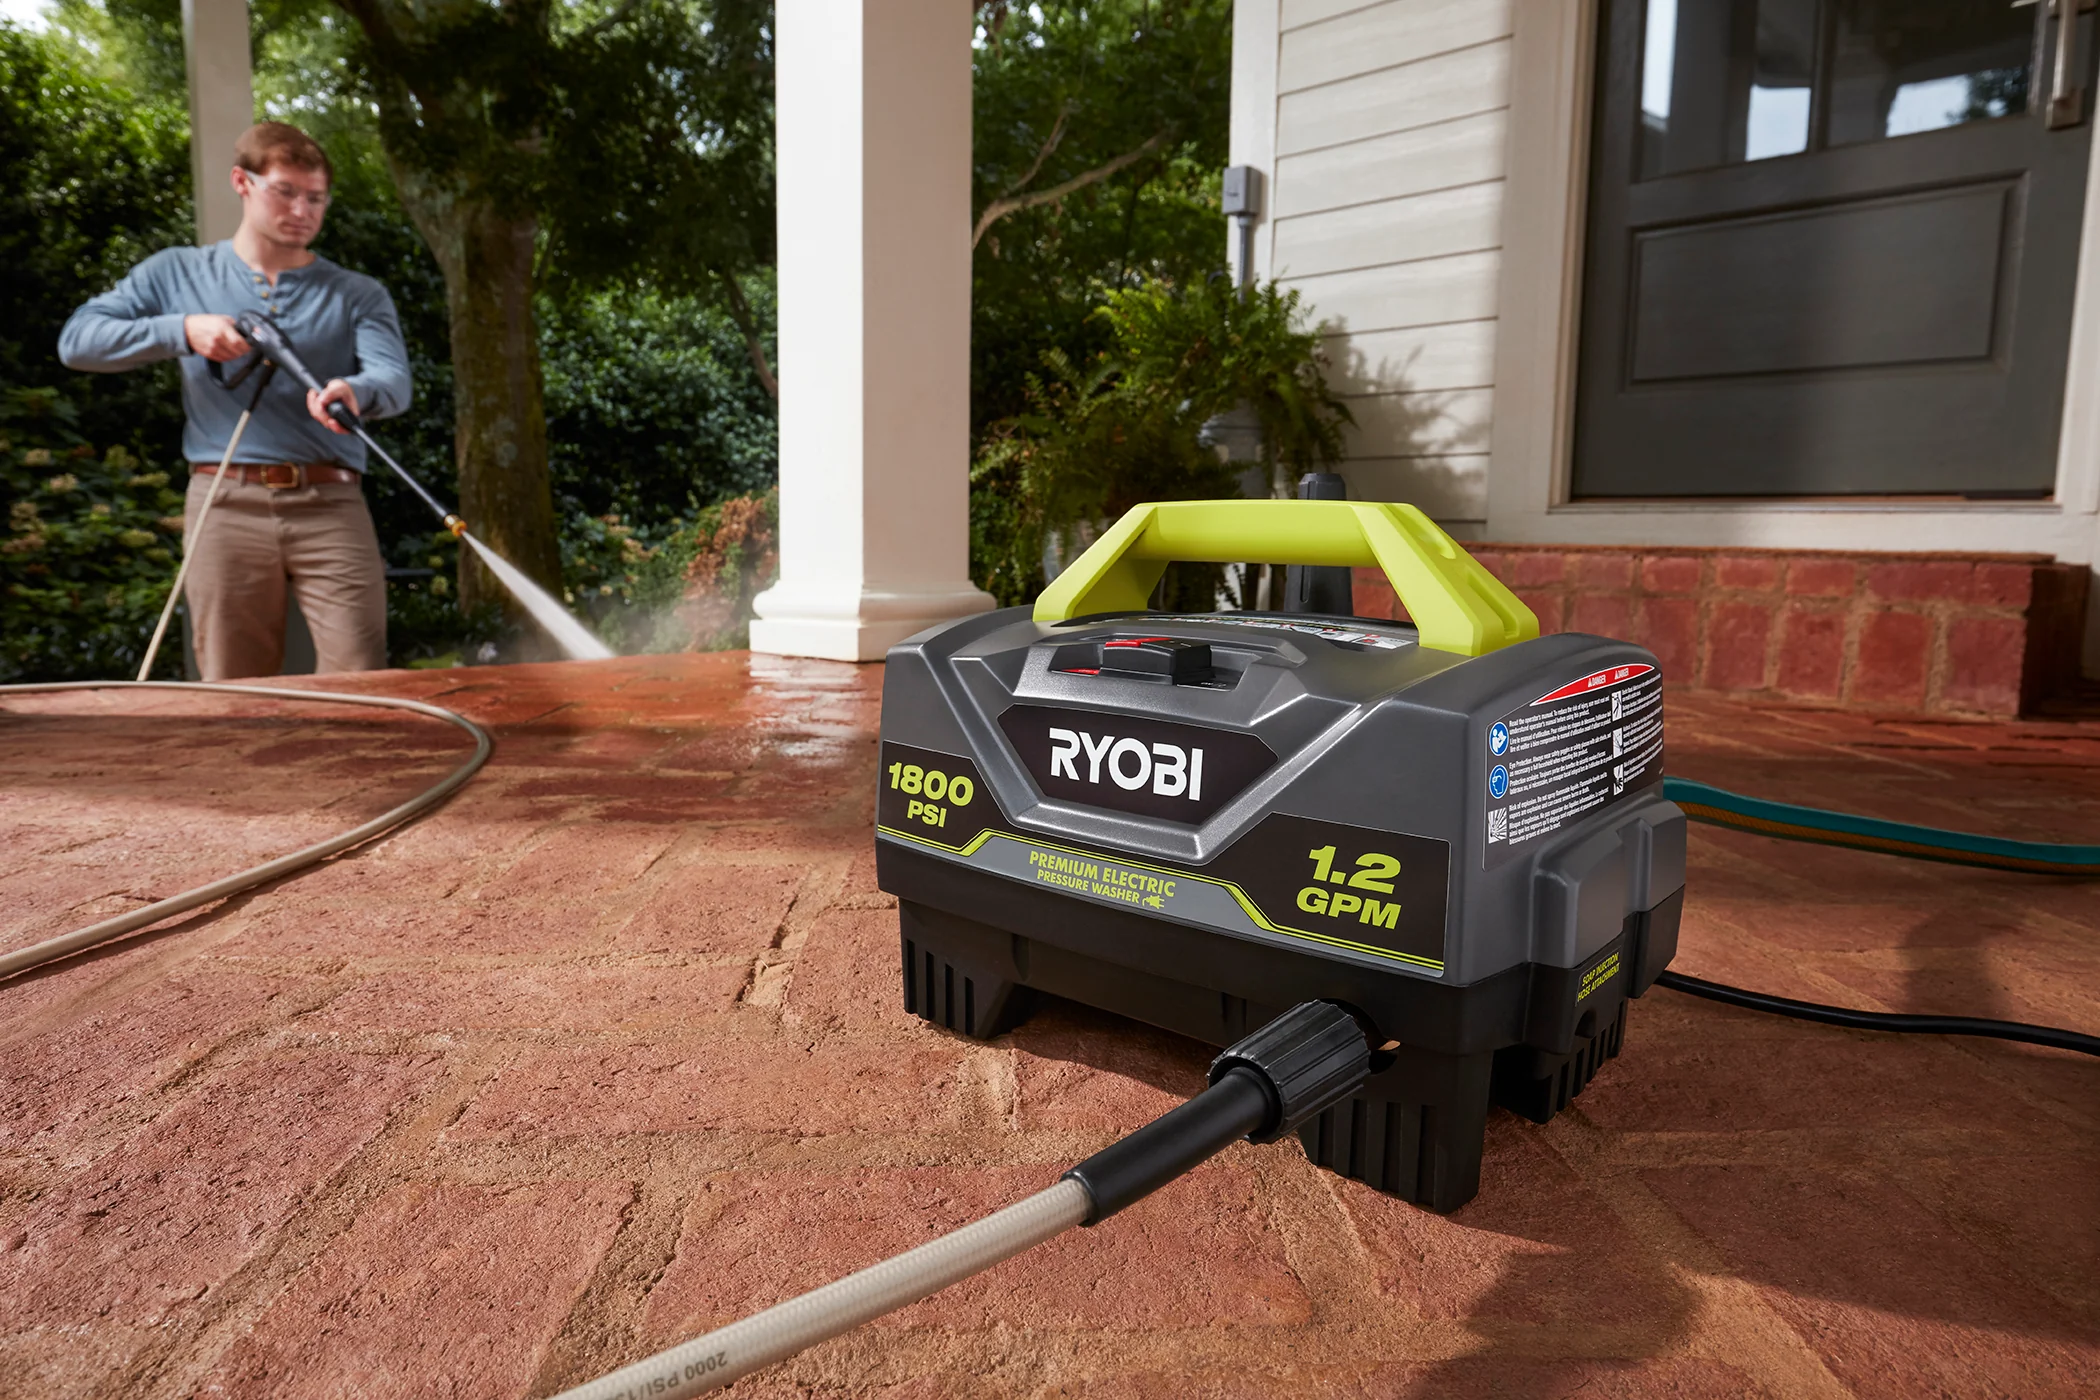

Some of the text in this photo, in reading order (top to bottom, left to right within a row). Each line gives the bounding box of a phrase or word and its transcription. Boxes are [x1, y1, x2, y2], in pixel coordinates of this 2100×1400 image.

[889, 762, 974, 806] 1800
[1050, 727, 1203, 801] RYOBI
[907, 800, 947, 828] PSI
[1029, 851, 1176, 897] PREMIUM ELECTRIC
[1037, 869, 1140, 903] PRESSURE WASHER
[1308, 845, 1401, 894] 1.2
[1297, 887, 1402, 930] GPM
[1577, 962, 1620, 1002] HOSE ATTACHMENT
[1582, 969, 1596, 987] SOAP
[684, 1351, 728, 1380] 2000
